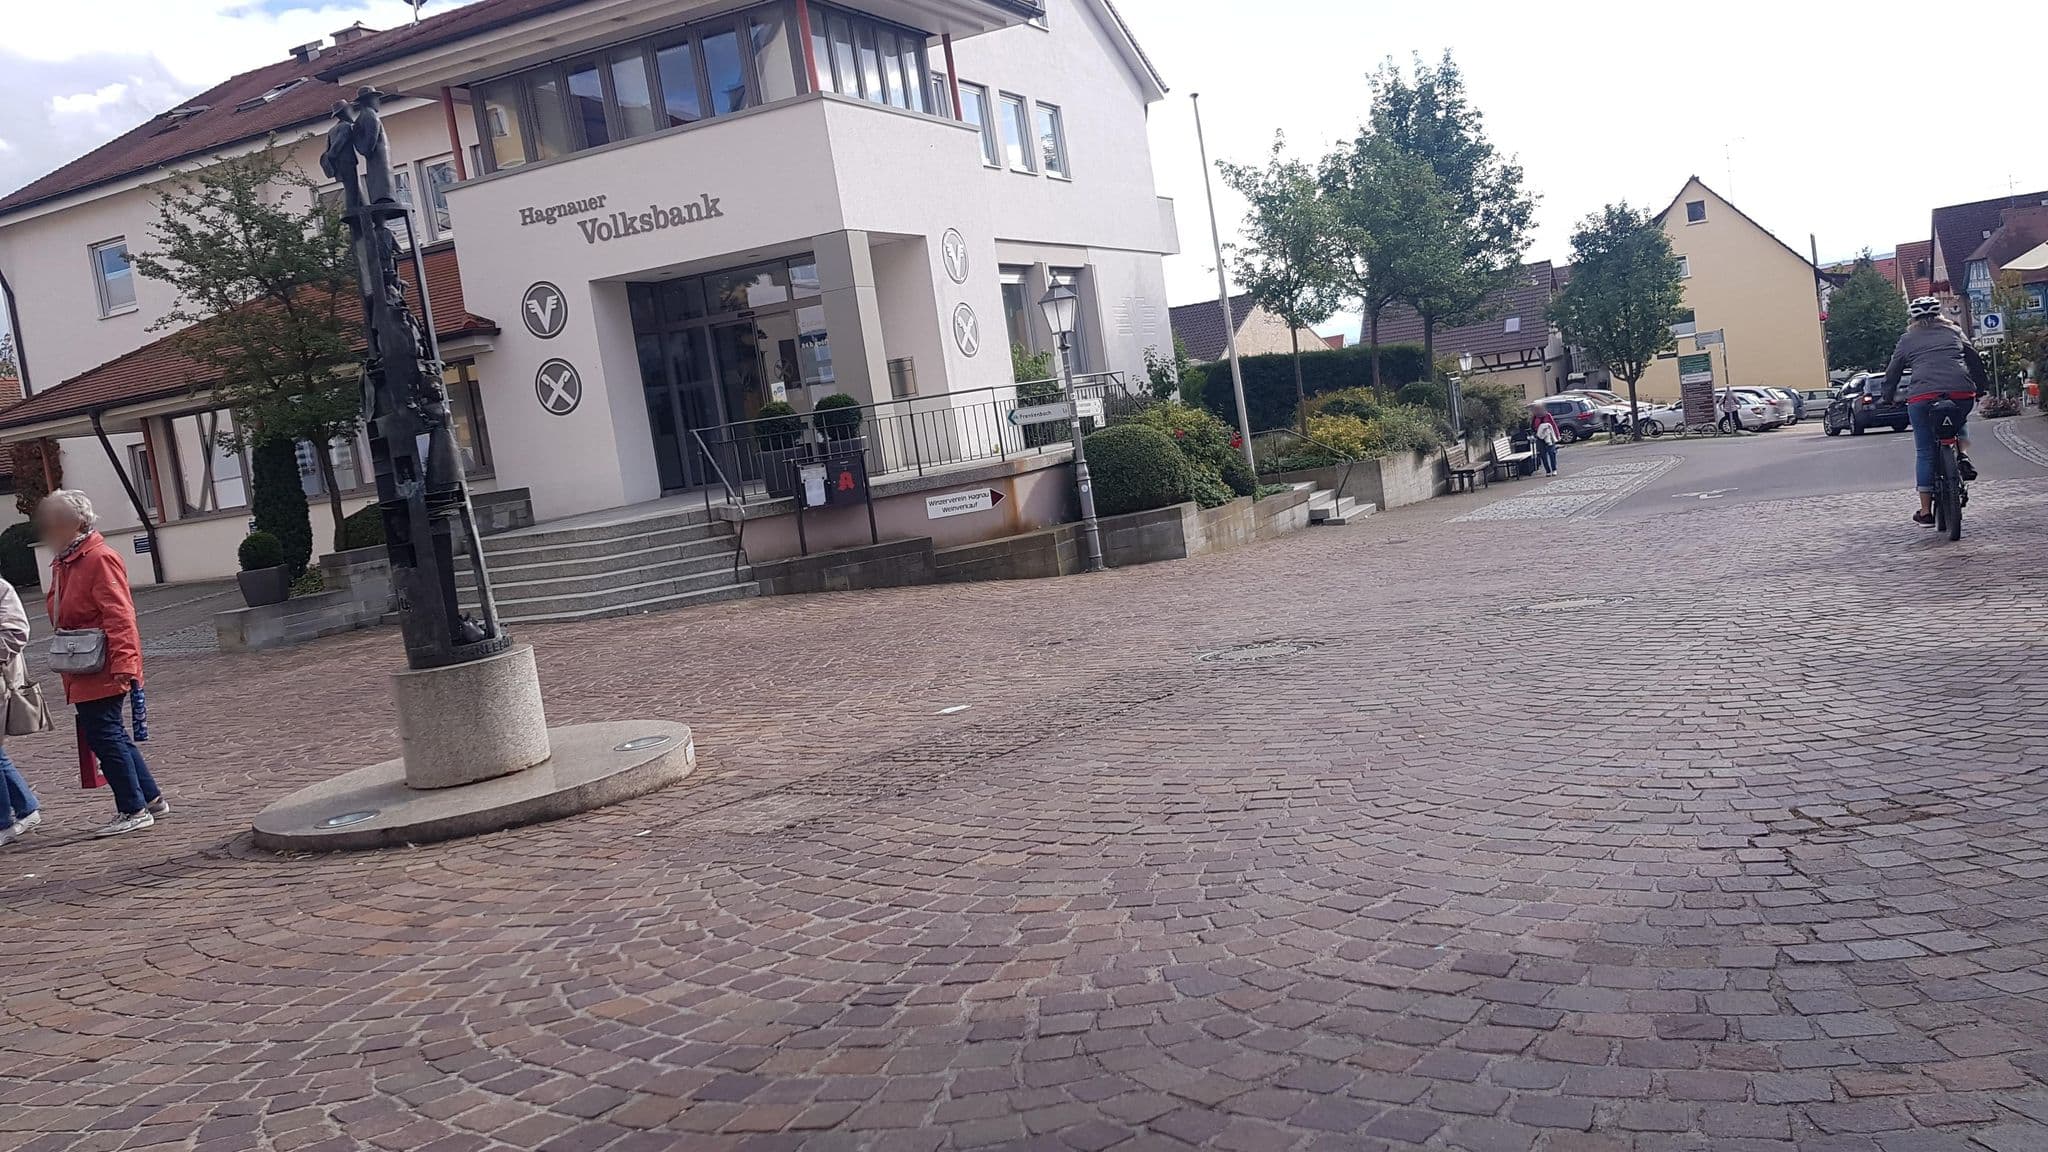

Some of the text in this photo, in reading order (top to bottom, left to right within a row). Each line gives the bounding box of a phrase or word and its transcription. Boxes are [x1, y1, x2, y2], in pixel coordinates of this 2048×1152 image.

[519, 194, 607, 225] Hagnauer
[577, 193, 724, 244] Volksbank
[928, 491, 989, 506] Winzerverein Hagnau
[941, 502, 978, 513] Weinverkauf
